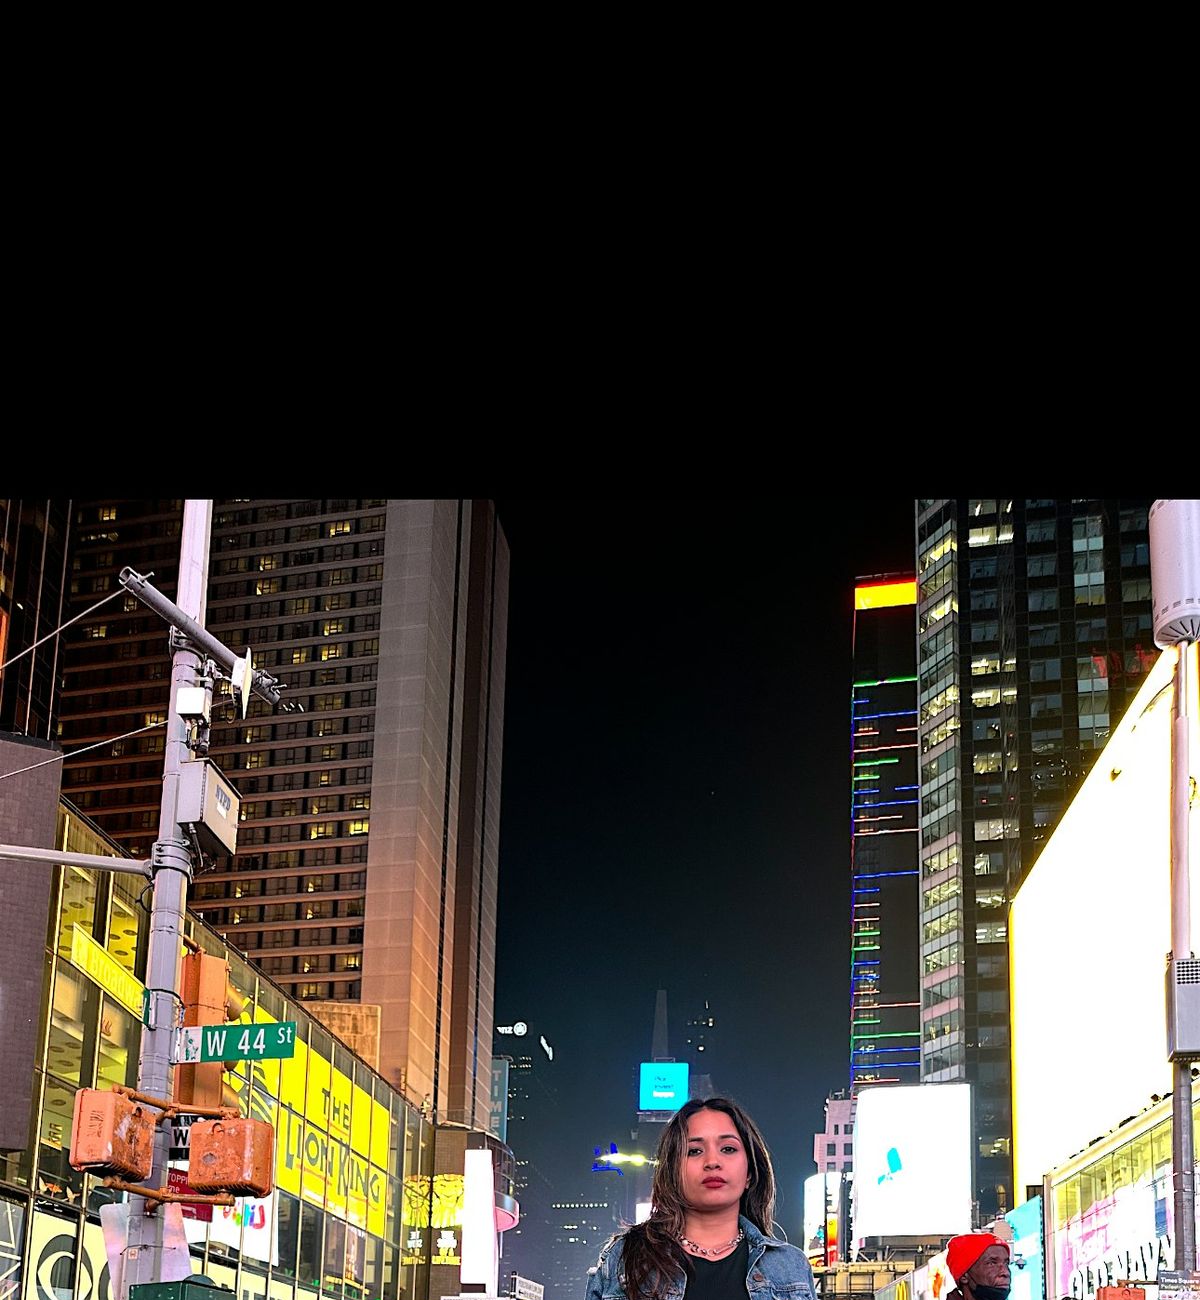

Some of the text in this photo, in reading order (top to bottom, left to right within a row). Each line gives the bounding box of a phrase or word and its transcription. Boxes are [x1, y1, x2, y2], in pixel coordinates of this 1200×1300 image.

[215, 784, 231, 811] NYPD
[207, 1026, 292, 1057] W 44 St
[321, 1087, 350, 1130] THE
[285, 1101, 380, 1203] LION KING
[1160, 1276, 1178, 1284] Times
